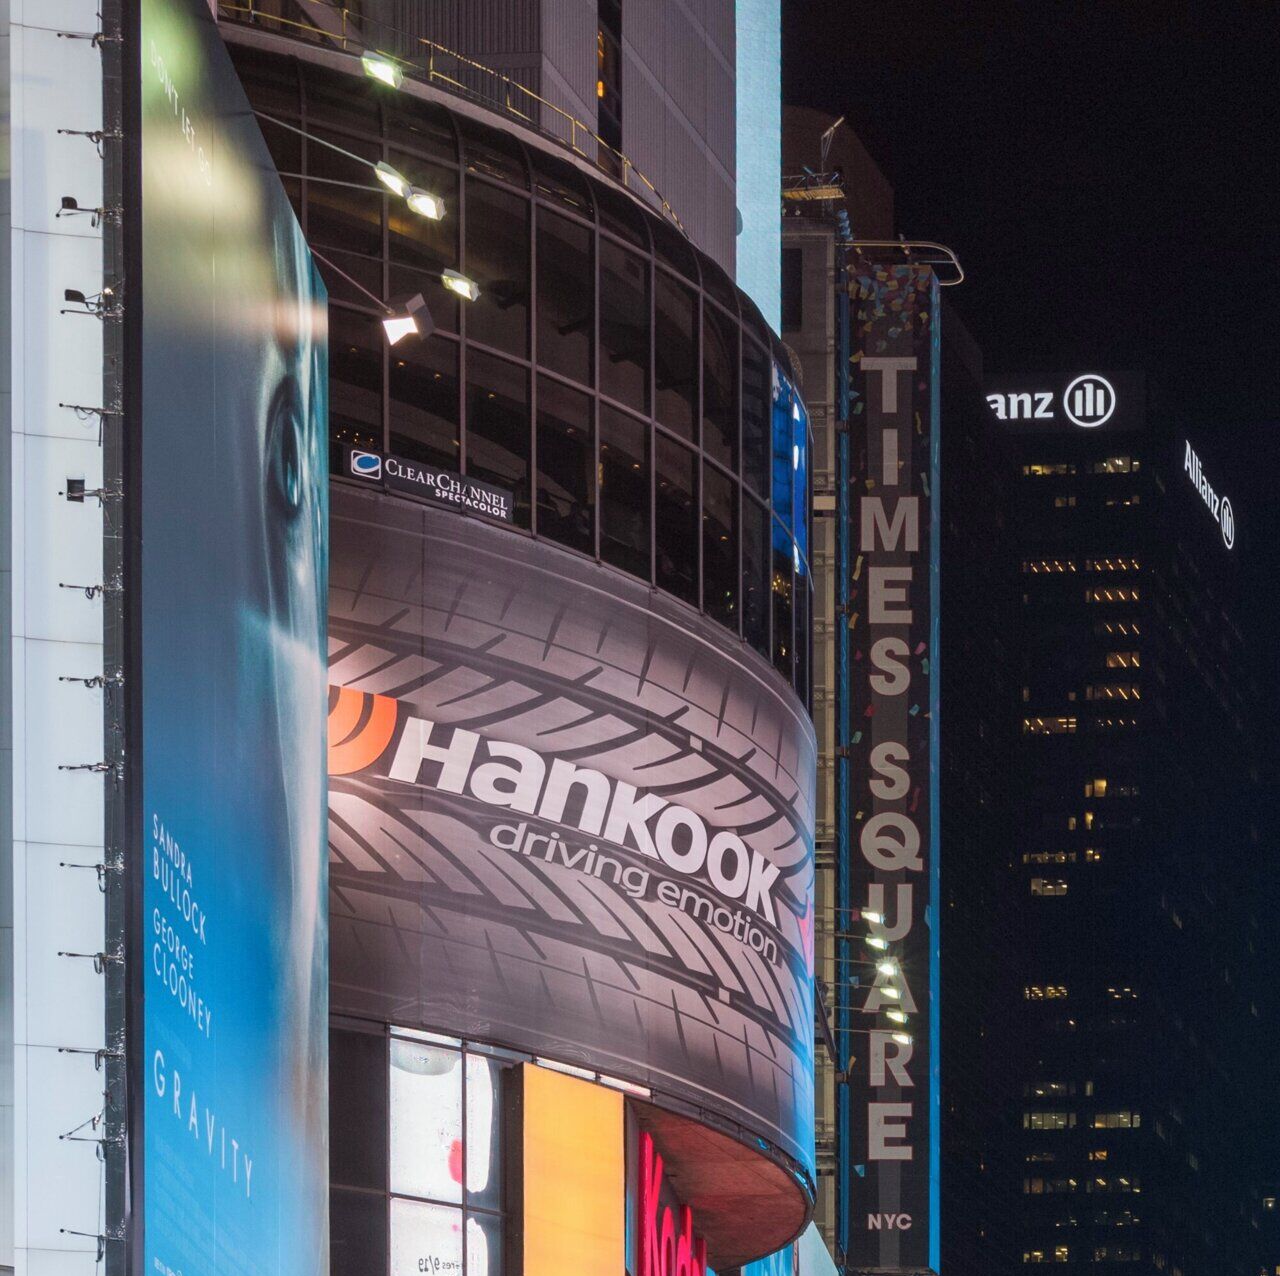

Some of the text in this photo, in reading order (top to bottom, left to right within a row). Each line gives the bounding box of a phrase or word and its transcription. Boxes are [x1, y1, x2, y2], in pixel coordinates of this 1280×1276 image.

[435, 487, 507, 519] SPECTACOLOR
[1184, 440, 1220, 523] Allianz
[859, 356, 923, 1162] TIMES SQUARE
[153, 813, 193, 889] SANDRA
[153, 846, 207, 946] BULLOCK
[489, 821, 778, 966] driving emotion
[153, 907, 194, 980] GEORGE
[153, 943, 212, 1040] CLOONEY
[153, 1049, 253, 1199] GRAVITY
[867, 1213, 912, 1231] NYC
